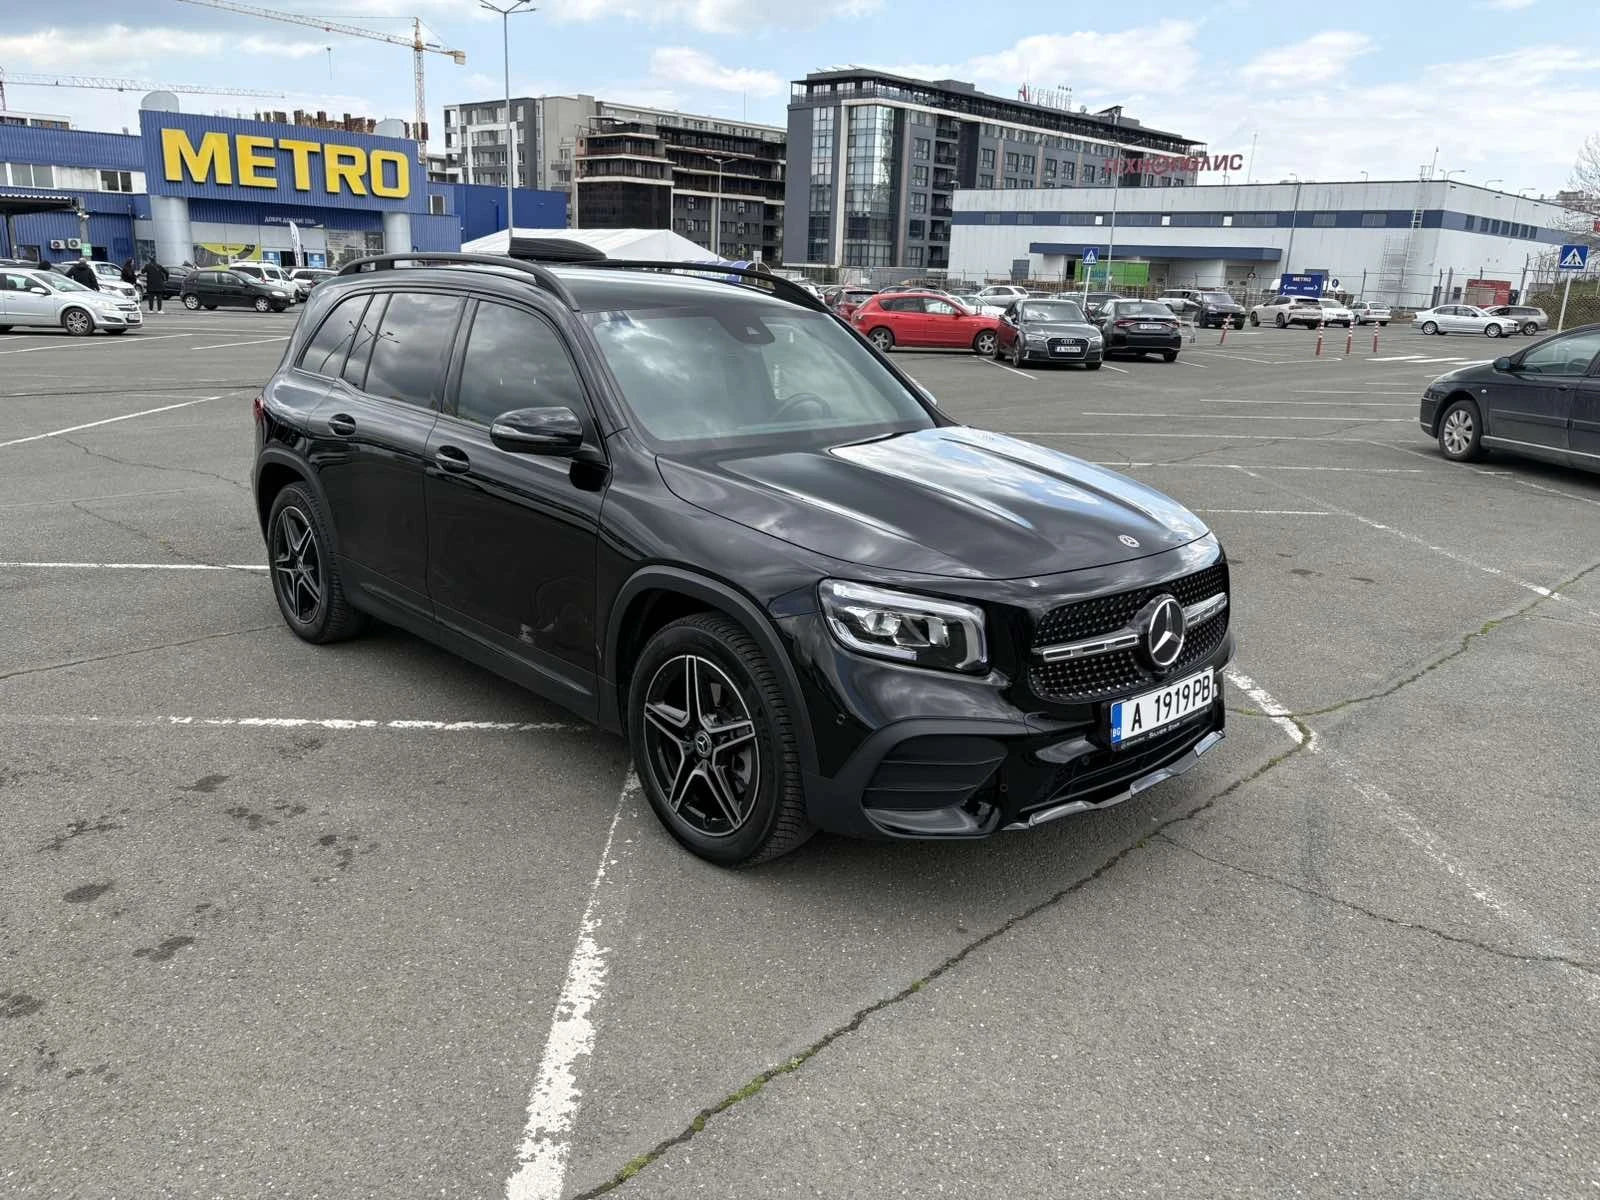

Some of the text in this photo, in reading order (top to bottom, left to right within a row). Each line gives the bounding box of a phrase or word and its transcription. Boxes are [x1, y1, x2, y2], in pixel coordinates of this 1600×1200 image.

[161, 128, 410, 199] METRO
[1104, 154, 1244, 176] ТЕХНОПОЛИС
[1131, 675, 1210, 732] A 1919PB
